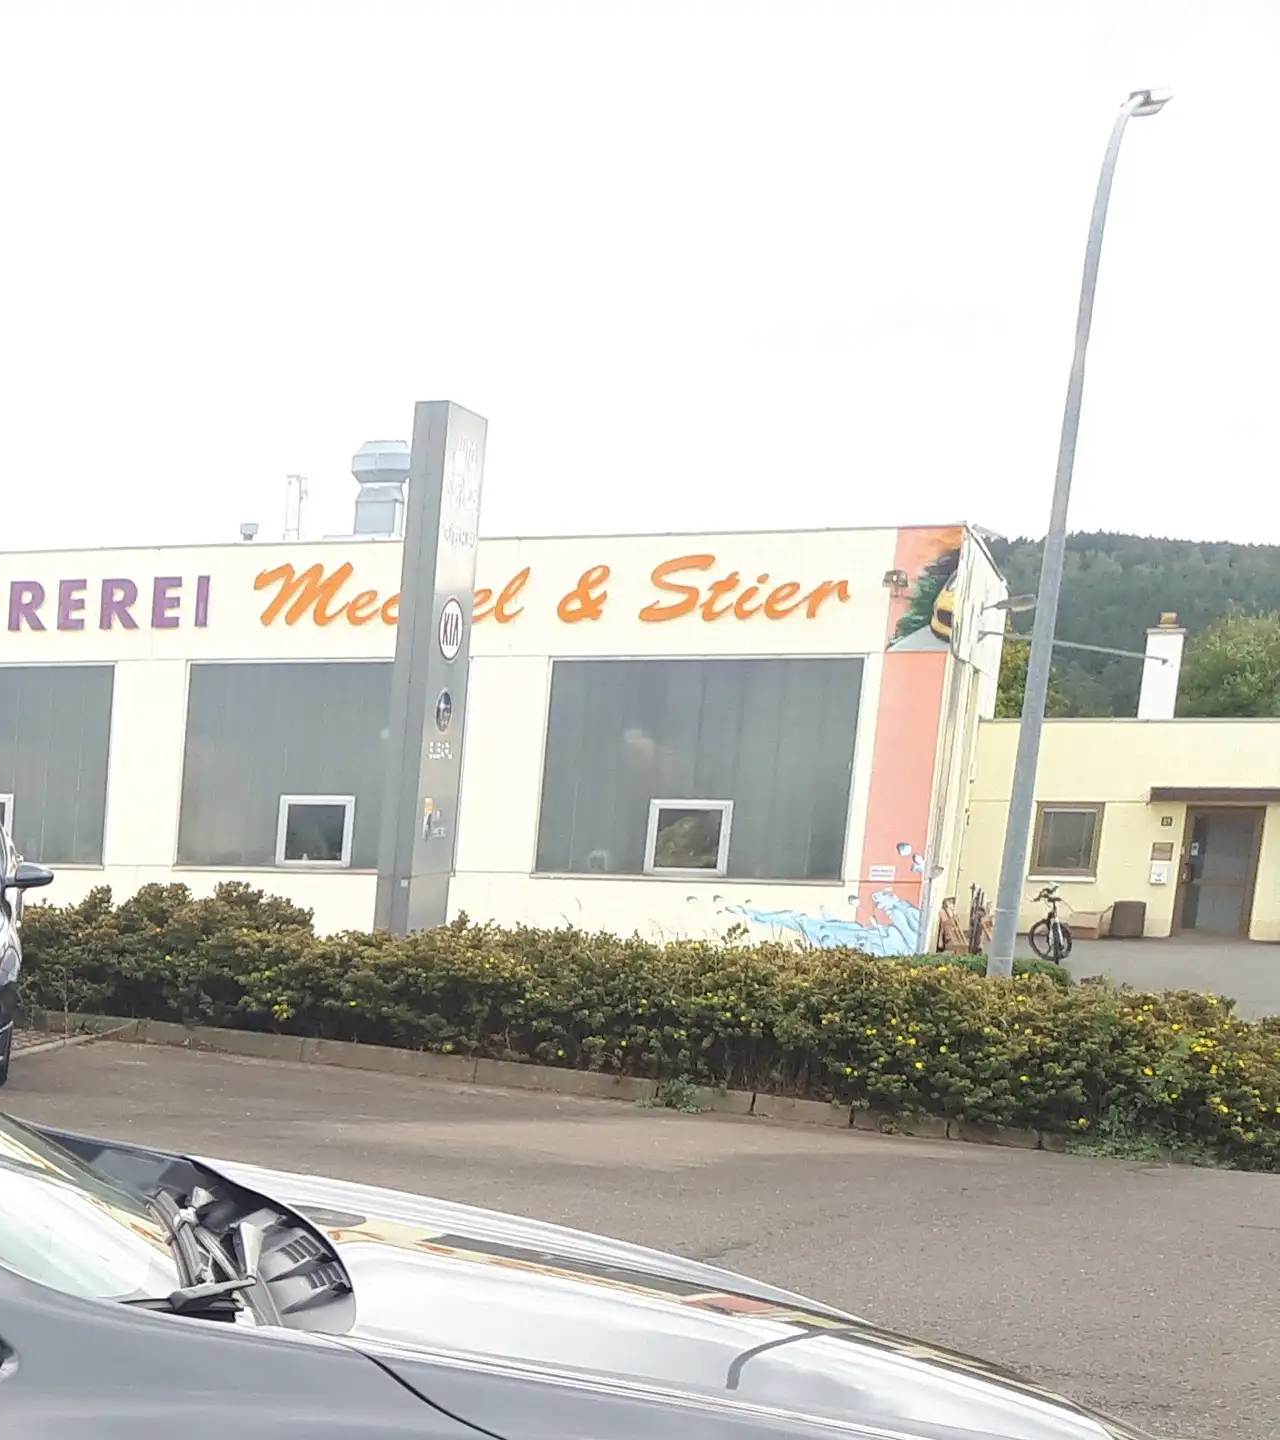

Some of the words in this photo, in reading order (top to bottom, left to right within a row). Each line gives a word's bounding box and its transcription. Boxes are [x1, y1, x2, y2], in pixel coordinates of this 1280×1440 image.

[556, 564, 611, 624] &
[638, 553, 851, 623] Stier
[441, 611, 460, 647] KIA
